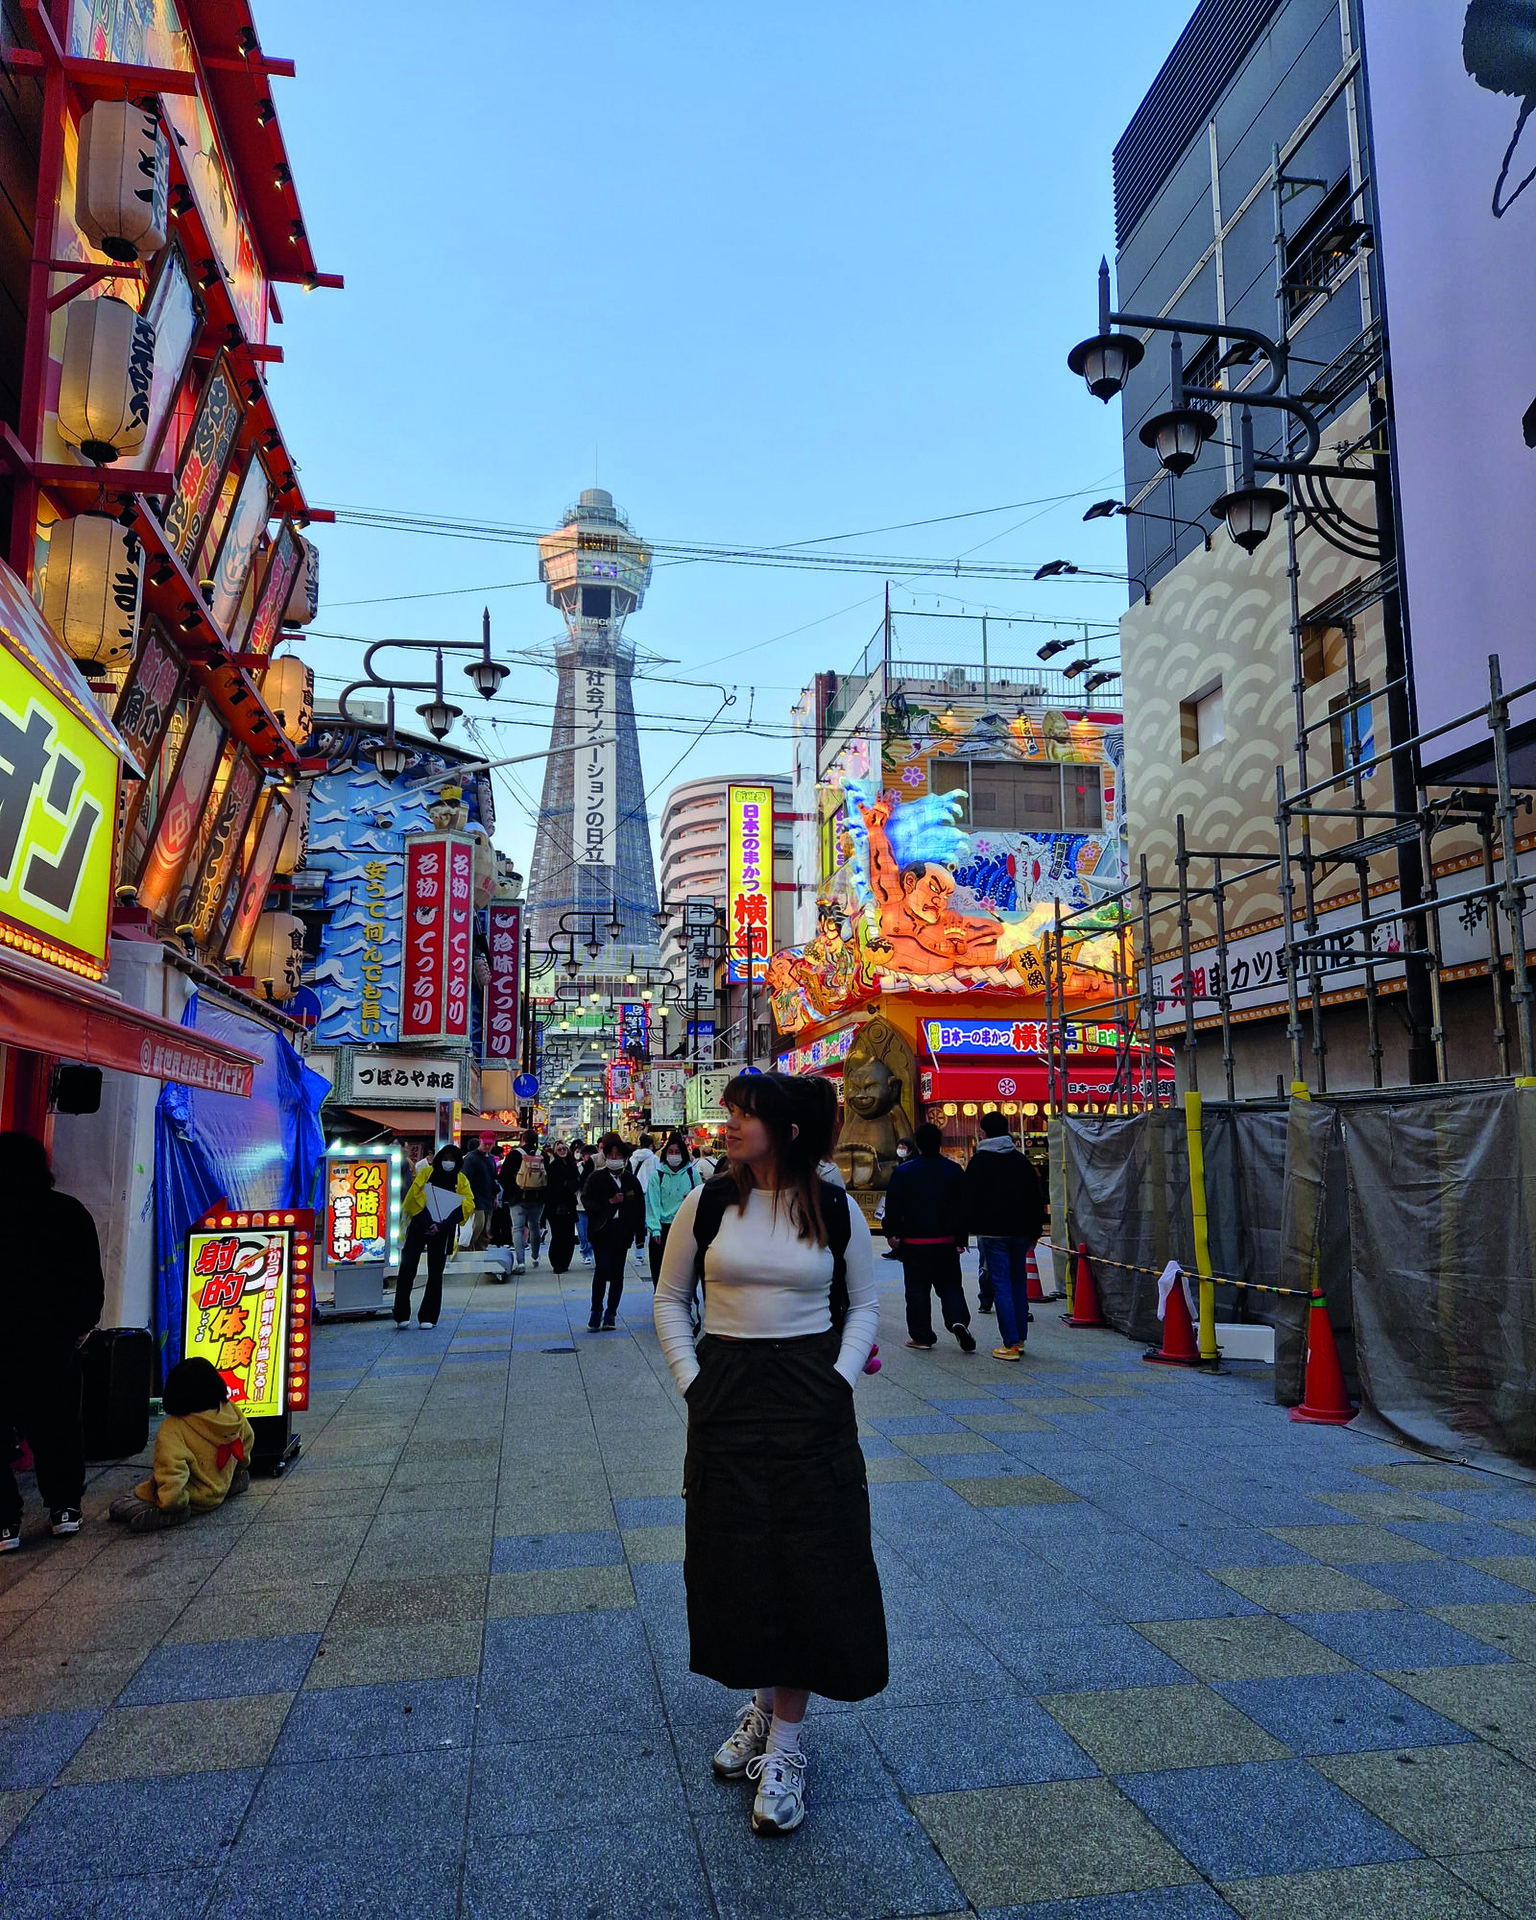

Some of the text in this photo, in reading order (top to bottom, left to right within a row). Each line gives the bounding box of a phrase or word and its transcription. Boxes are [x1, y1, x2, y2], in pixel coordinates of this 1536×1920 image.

[120, 684, 162, 749] 魚介
[585, 670, 605, 863] 社会イノベーションの日立
[735, 790, 766, 803] 新世界
[742, 804, 760, 891] 日本一の串かつ
[361, 860, 388, 1035] 安うて何んでも旨い
[412, 852, 439, 1025] 名物 てっちり
[448, 853, 469, 1026] 名物 てっちり
[734, 893, 768, 959] 横綱
[491, 931, 514, 1055] 珍味てっちり
[1019, 950, 1047, 991] 横綱
[940, 1027, 1010, 1046] 日本一の串かつ
[1012, 1022, 1062, 1052] 横綱
[359, 1068, 455, 1090] づぼらや本店
[333, 1196, 353, 1259] 営業中
[354, 1166, 382, 1240] 24時間
[195, 1239, 257, 1371] 射的体験
[195, 1311, 209, 1343] しゃてき
